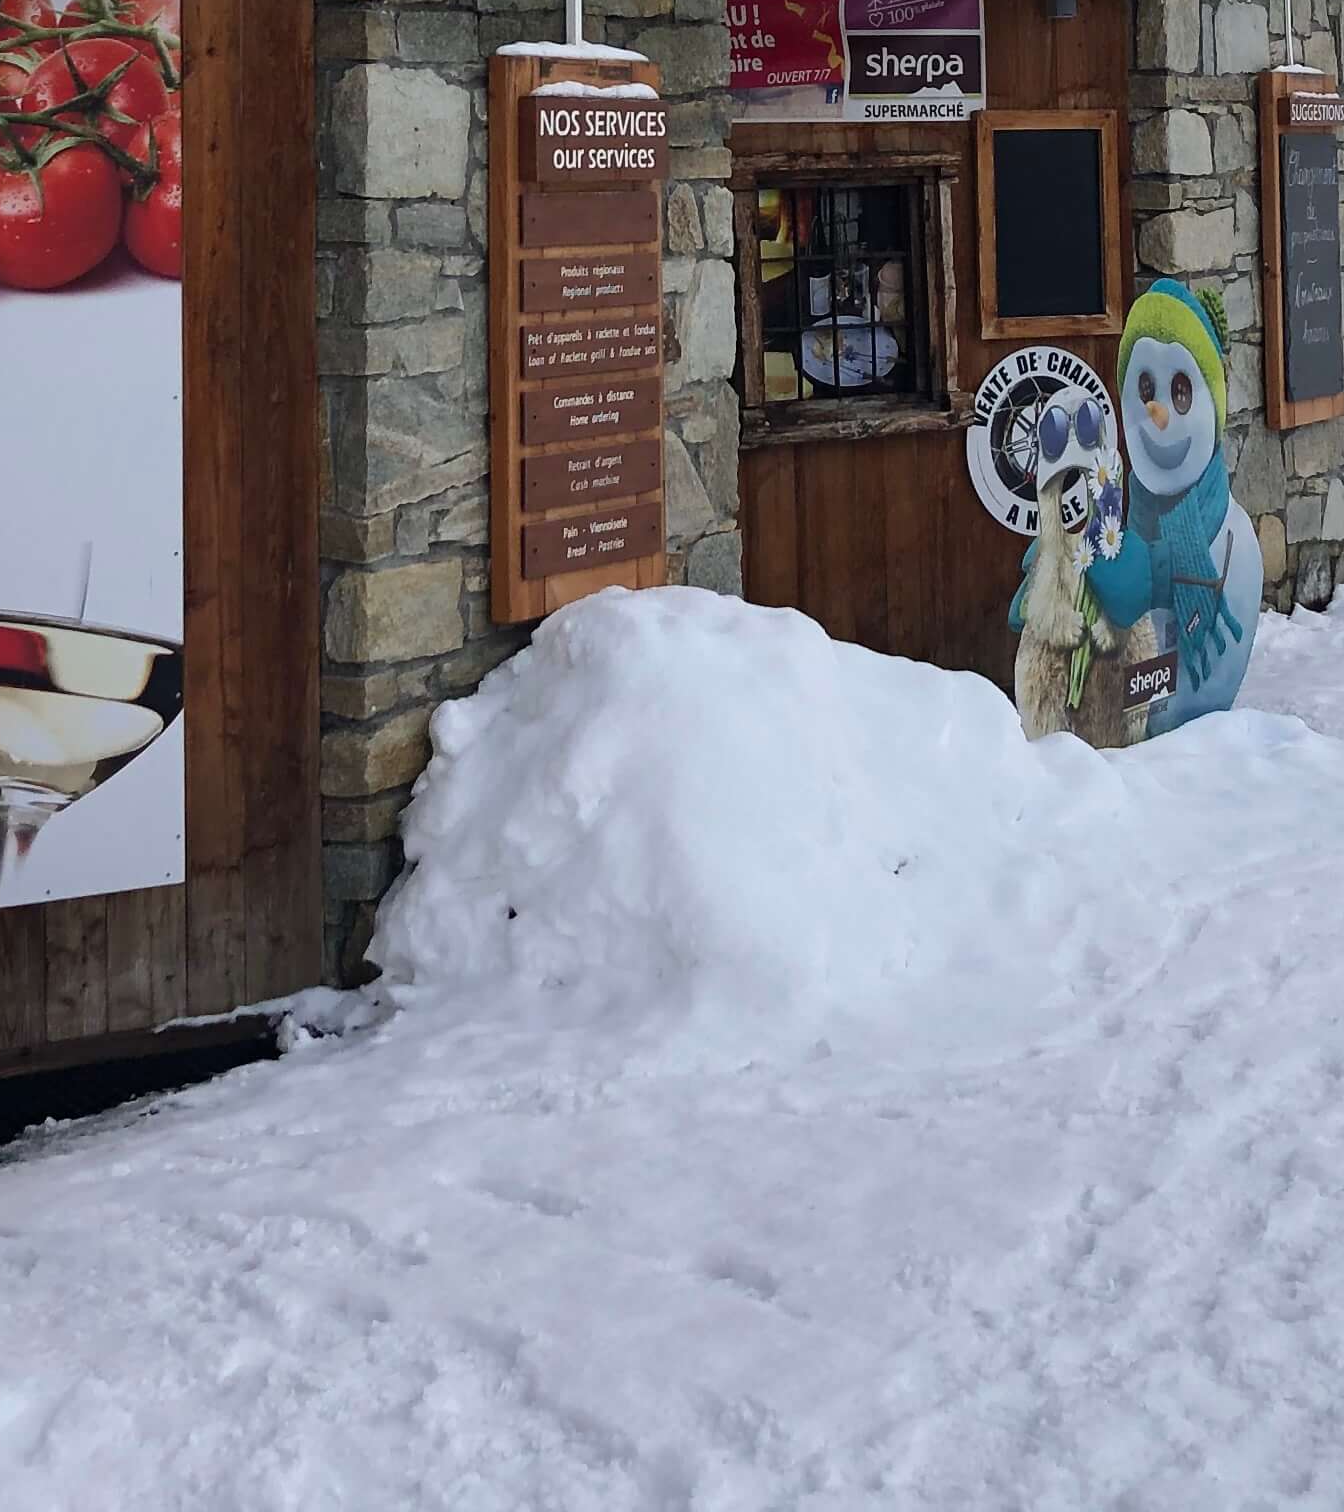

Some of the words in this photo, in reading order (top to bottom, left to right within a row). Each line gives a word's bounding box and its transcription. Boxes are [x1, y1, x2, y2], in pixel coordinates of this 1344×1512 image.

[751, 29, 776, 48] de
[865, 47, 964, 82] sherpa
[767, 70, 813, 84] OUVERT
[813, 68, 831, 81] 7/7
[864, 101, 964, 118] SUPERMARCHÉ
[1291, 104, 1344, 120] SUGGESTIONS
[540, 110, 580, 137] NOS
[585, 111, 666, 137] SERVICES
[553, 149, 584, 169] our
[588, 143, 655, 169] services
[560, 265, 589, 278] Produits
[562, 285, 592, 300] Regional
[634, 323, 656, 336] fondue
[528, 356, 545, 367] Loan
[549, 353, 556, 365] of
[619, 345, 641, 358] fondue
[973, 366, 1013, 427] VENTE
[1016, 351, 1038, 376] DE
[553, 395, 595, 409] Commandes
[598, 392, 603, 404] à
[606, 389, 635, 403] distance
[570, 414, 589, 426] Home
[591, 410, 620, 424] ordering
[568, 459, 591, 473] Retrait
[594, 454, 623, 470] d'argent
[570, 478, 589, 492] Cash
[591, 474, 621, 488] machine
[1006, 503, 1020, 525] A
[563, 526, 579, 539] Pain
[589, 517, 628, 534] Viennoiserie
[567, 543, 588, 559] Bread
[598, 538, 625, 553] Pastries
[1129, 667, 1171, 695] sherpa
